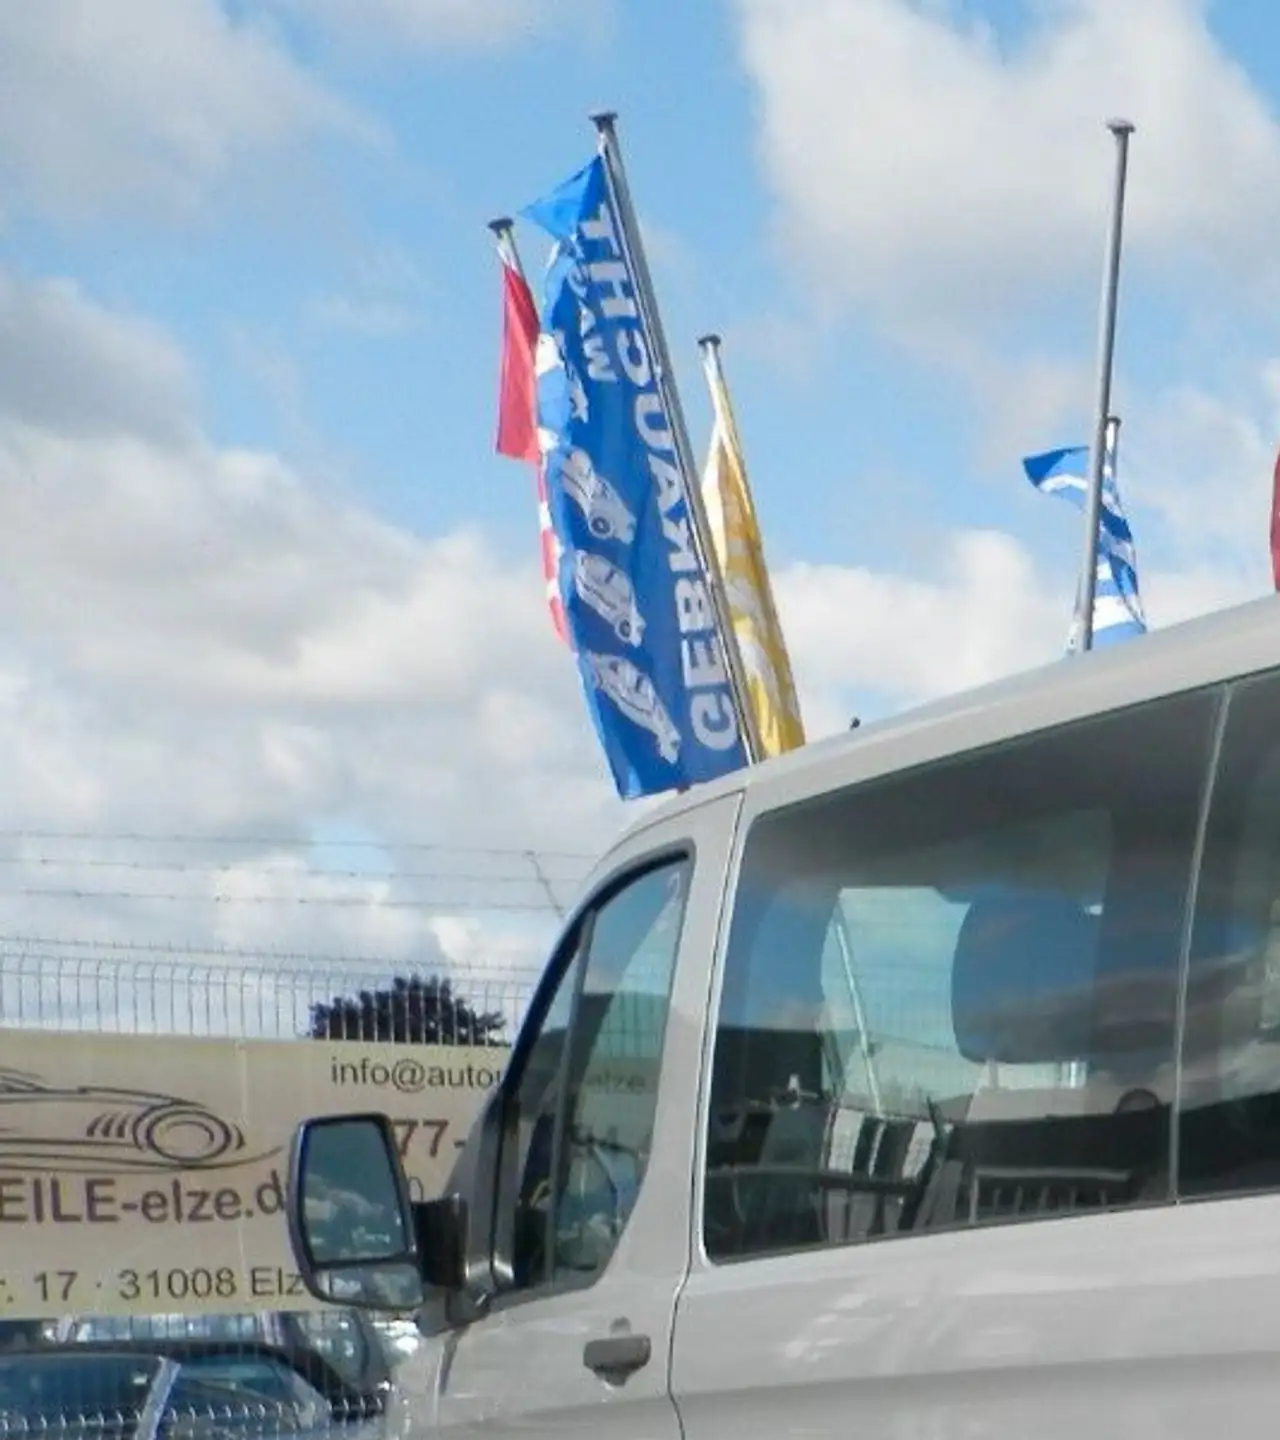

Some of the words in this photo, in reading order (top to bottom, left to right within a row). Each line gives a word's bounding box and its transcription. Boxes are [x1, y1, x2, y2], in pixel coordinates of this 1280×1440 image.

[331, 1056, 503, 1093] info@auto
[0, 1168, 286, 1224] EILE-elze.d
[34, 1271, 78, 1302] 17
[118, 1267, 237, 1300] 31008
[251, 1266, 304, 1297] Elz
